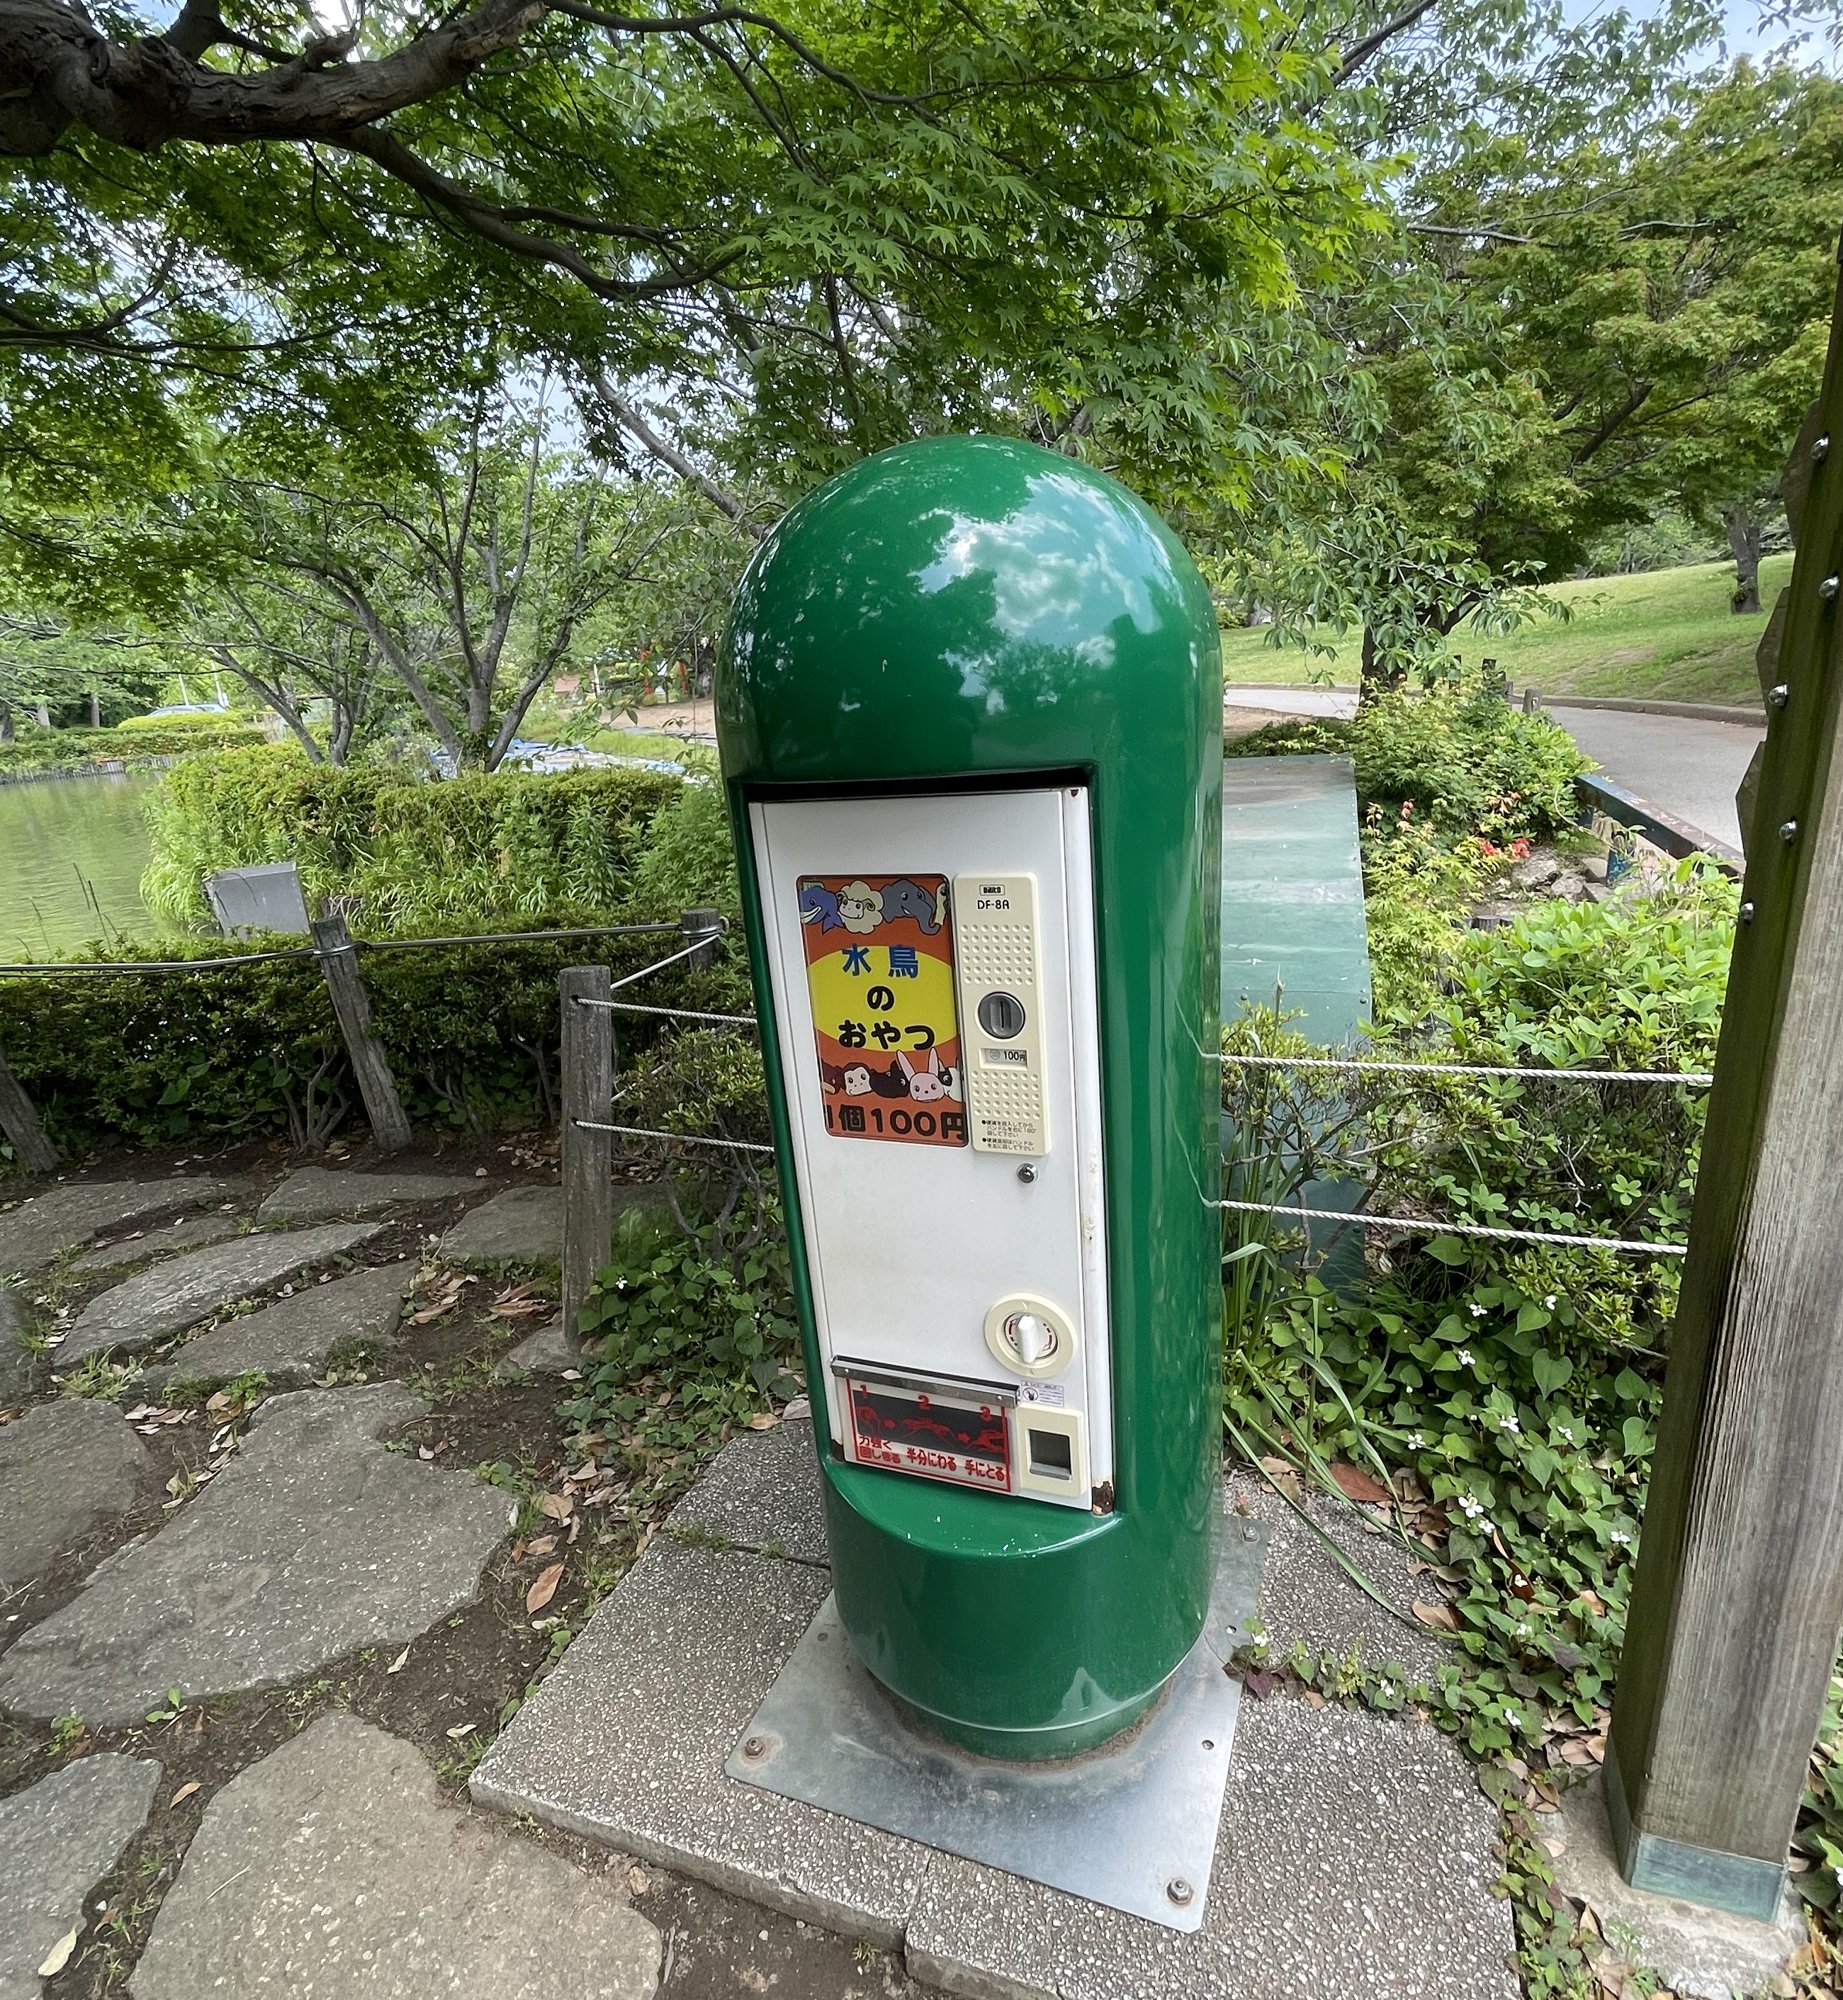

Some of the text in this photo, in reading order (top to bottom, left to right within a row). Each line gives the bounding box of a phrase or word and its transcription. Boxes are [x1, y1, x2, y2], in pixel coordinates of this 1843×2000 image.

[977, 899, 1010, 910] DF-8A
[842, 943, 919, 978] 水鳥
[866, 985, 895, 1011] の
[838, 1019, 935, 1050] おやつ
[1003, 1050, 1027, 1062] 100円
[906, 1447, 957, 1472] 半分にわる
[964, 1459, 1005, 1482] 手にとる
